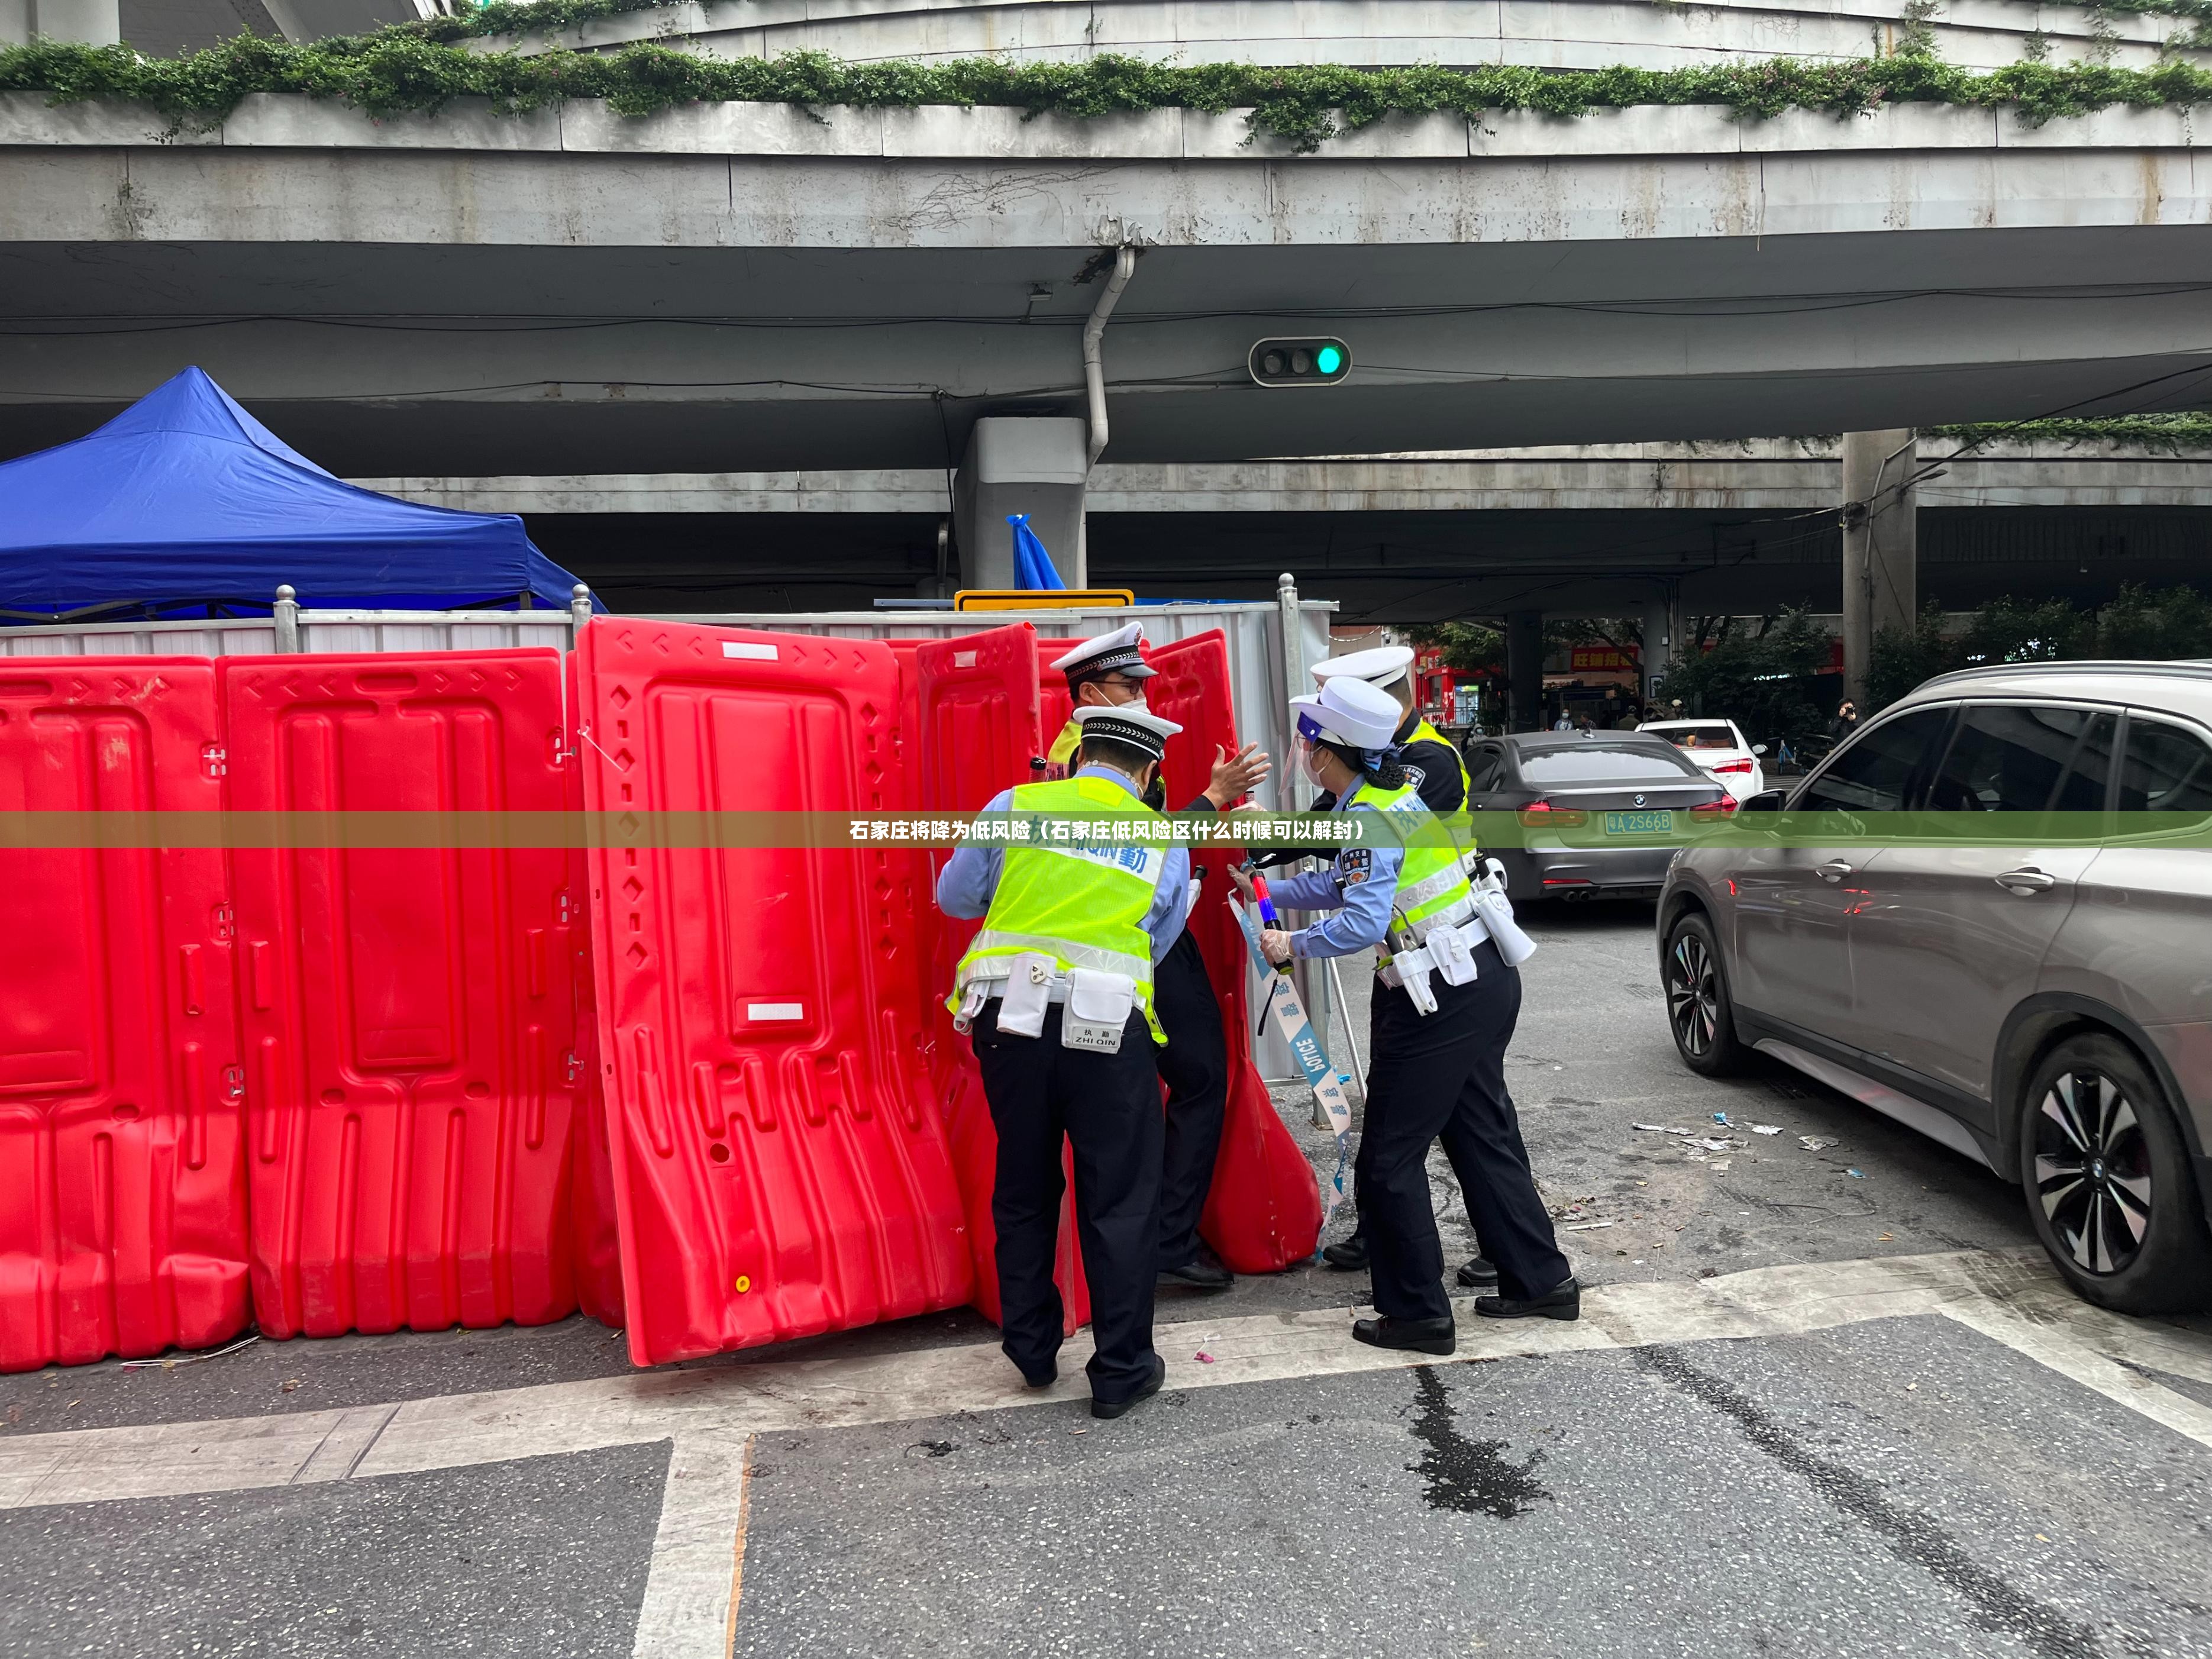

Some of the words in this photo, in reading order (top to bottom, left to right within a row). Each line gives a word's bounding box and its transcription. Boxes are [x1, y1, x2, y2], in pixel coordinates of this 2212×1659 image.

[1401, 767, 1423, 779] 人民共和国
